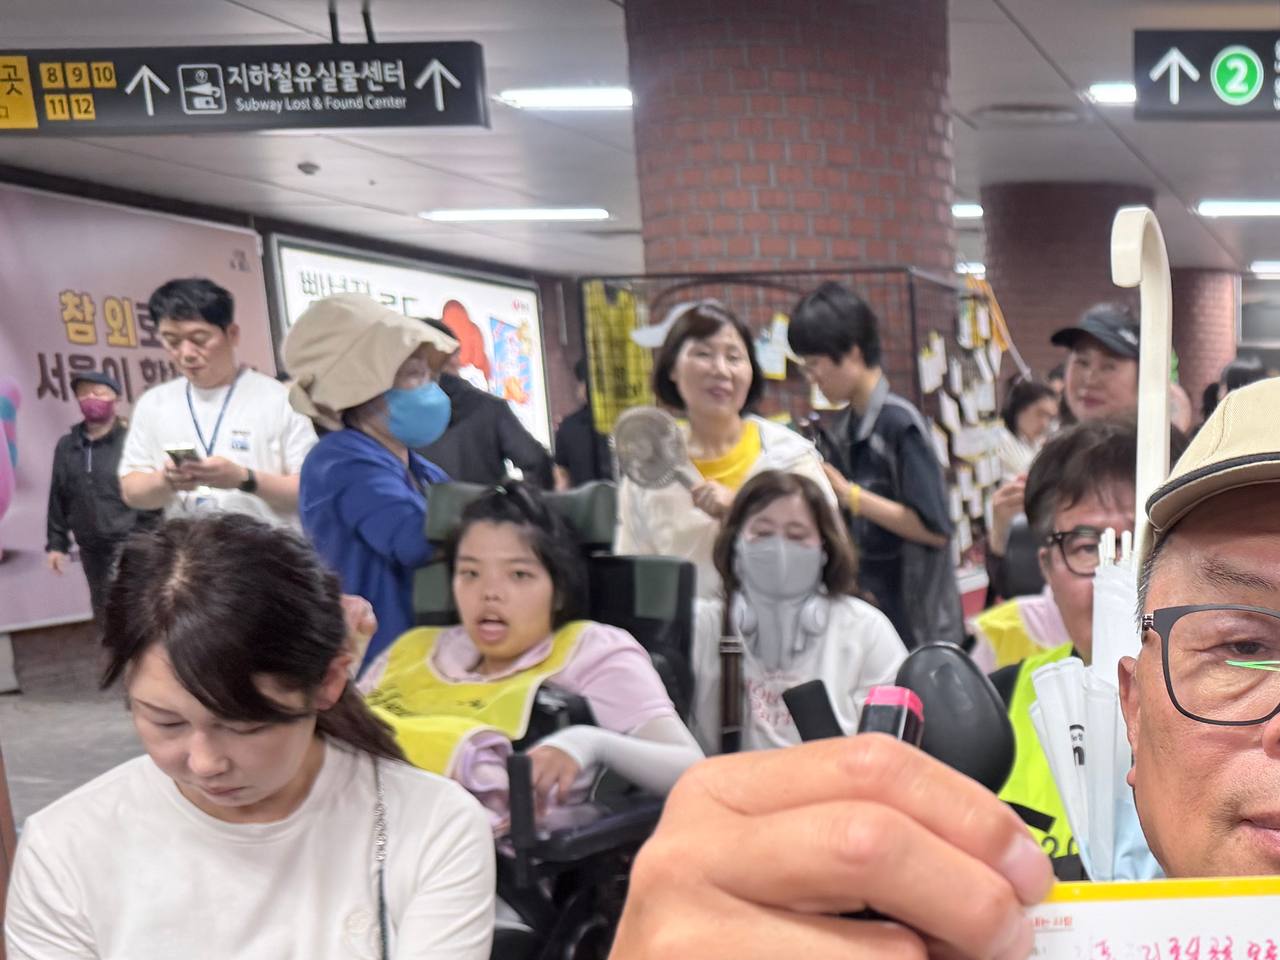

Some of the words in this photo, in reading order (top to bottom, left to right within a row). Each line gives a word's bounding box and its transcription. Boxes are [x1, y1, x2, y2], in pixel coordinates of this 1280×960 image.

[0, 65, 24, 96] 곳
[47, 67, 57, 83] 8
[72, 67, 82, 83] 9
[94, 66, 113, 82] 10
[227, 60, 406, 93] 지하철유실물센터
[1228, 59, 1248, 94] 2
[50, 99, 67, 115] 11
[74, 98, 92, 115] 12
[235, 97, 283, 114] Subway
[285, 97, 310, 111] Lost
[312, 97, 323, 110] &
[325, 96, 363, 111] Found
[366, 95, 407, 110] Center
